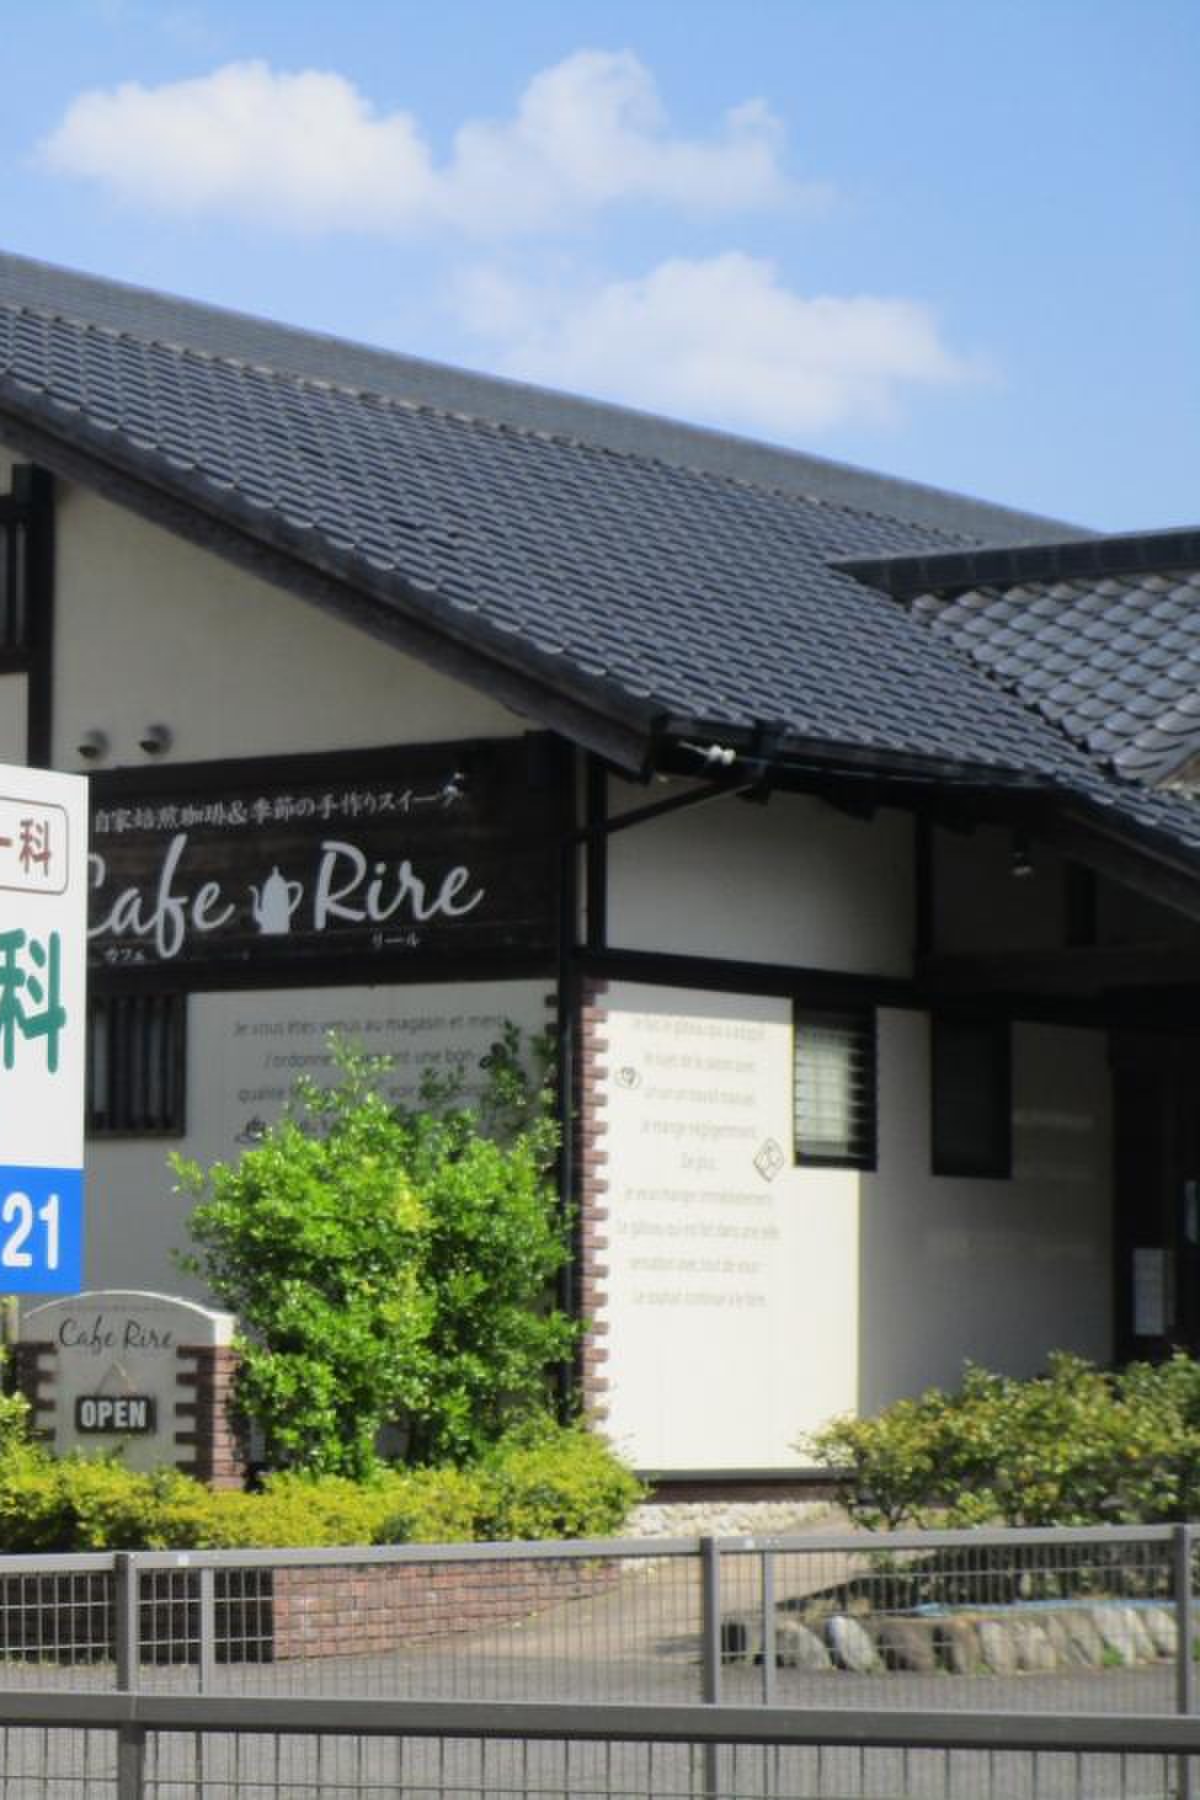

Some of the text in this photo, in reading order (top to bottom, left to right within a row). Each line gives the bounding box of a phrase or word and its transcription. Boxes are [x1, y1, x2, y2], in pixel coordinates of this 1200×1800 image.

[314, 841, 484, 930] Rire
[59, 1314, 174, 1354] Cafe Rire
[81, 1401, 147, 1428] OPEN
